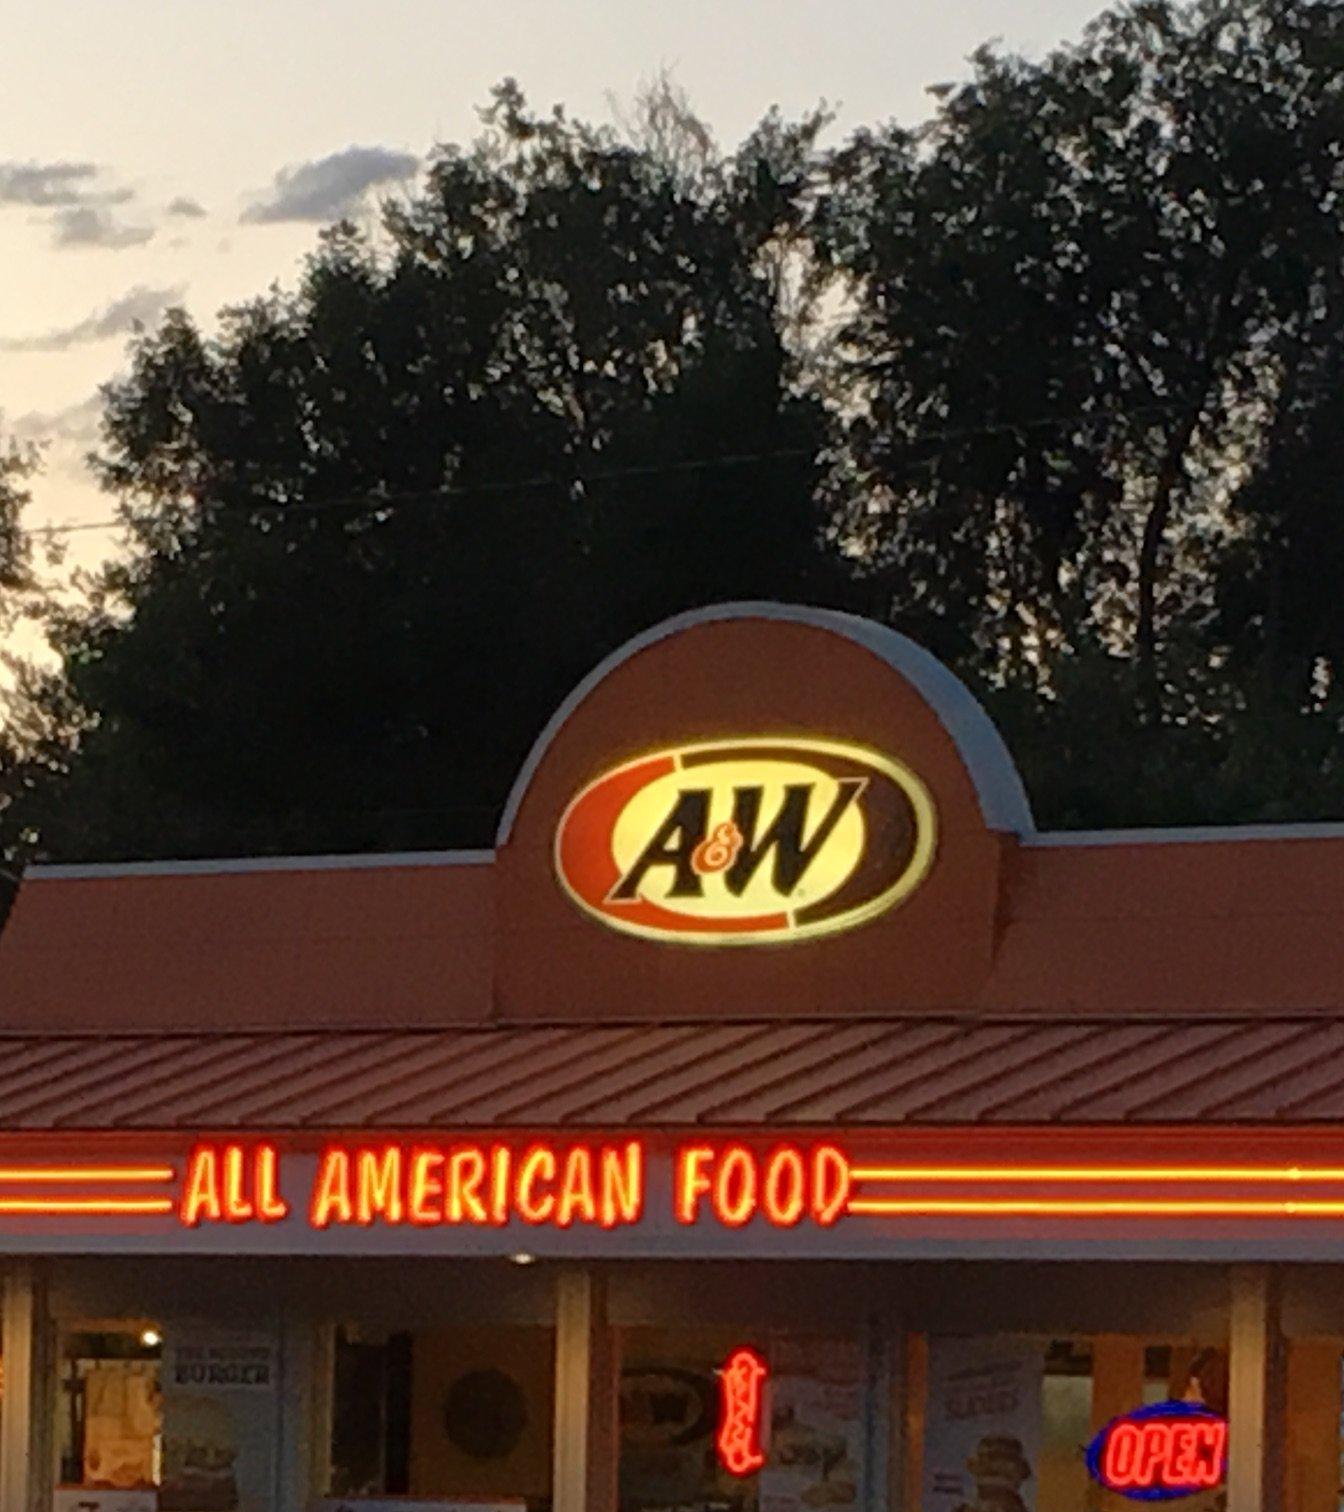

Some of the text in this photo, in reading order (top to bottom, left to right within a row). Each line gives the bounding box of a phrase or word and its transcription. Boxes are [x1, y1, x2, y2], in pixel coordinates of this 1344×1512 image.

[604, 776, 869, 905] A&W
[182, 1141, 852, 1229] ALL AMERICAN FOOD
[1105, 1421, 1226, 1486] OPEN
